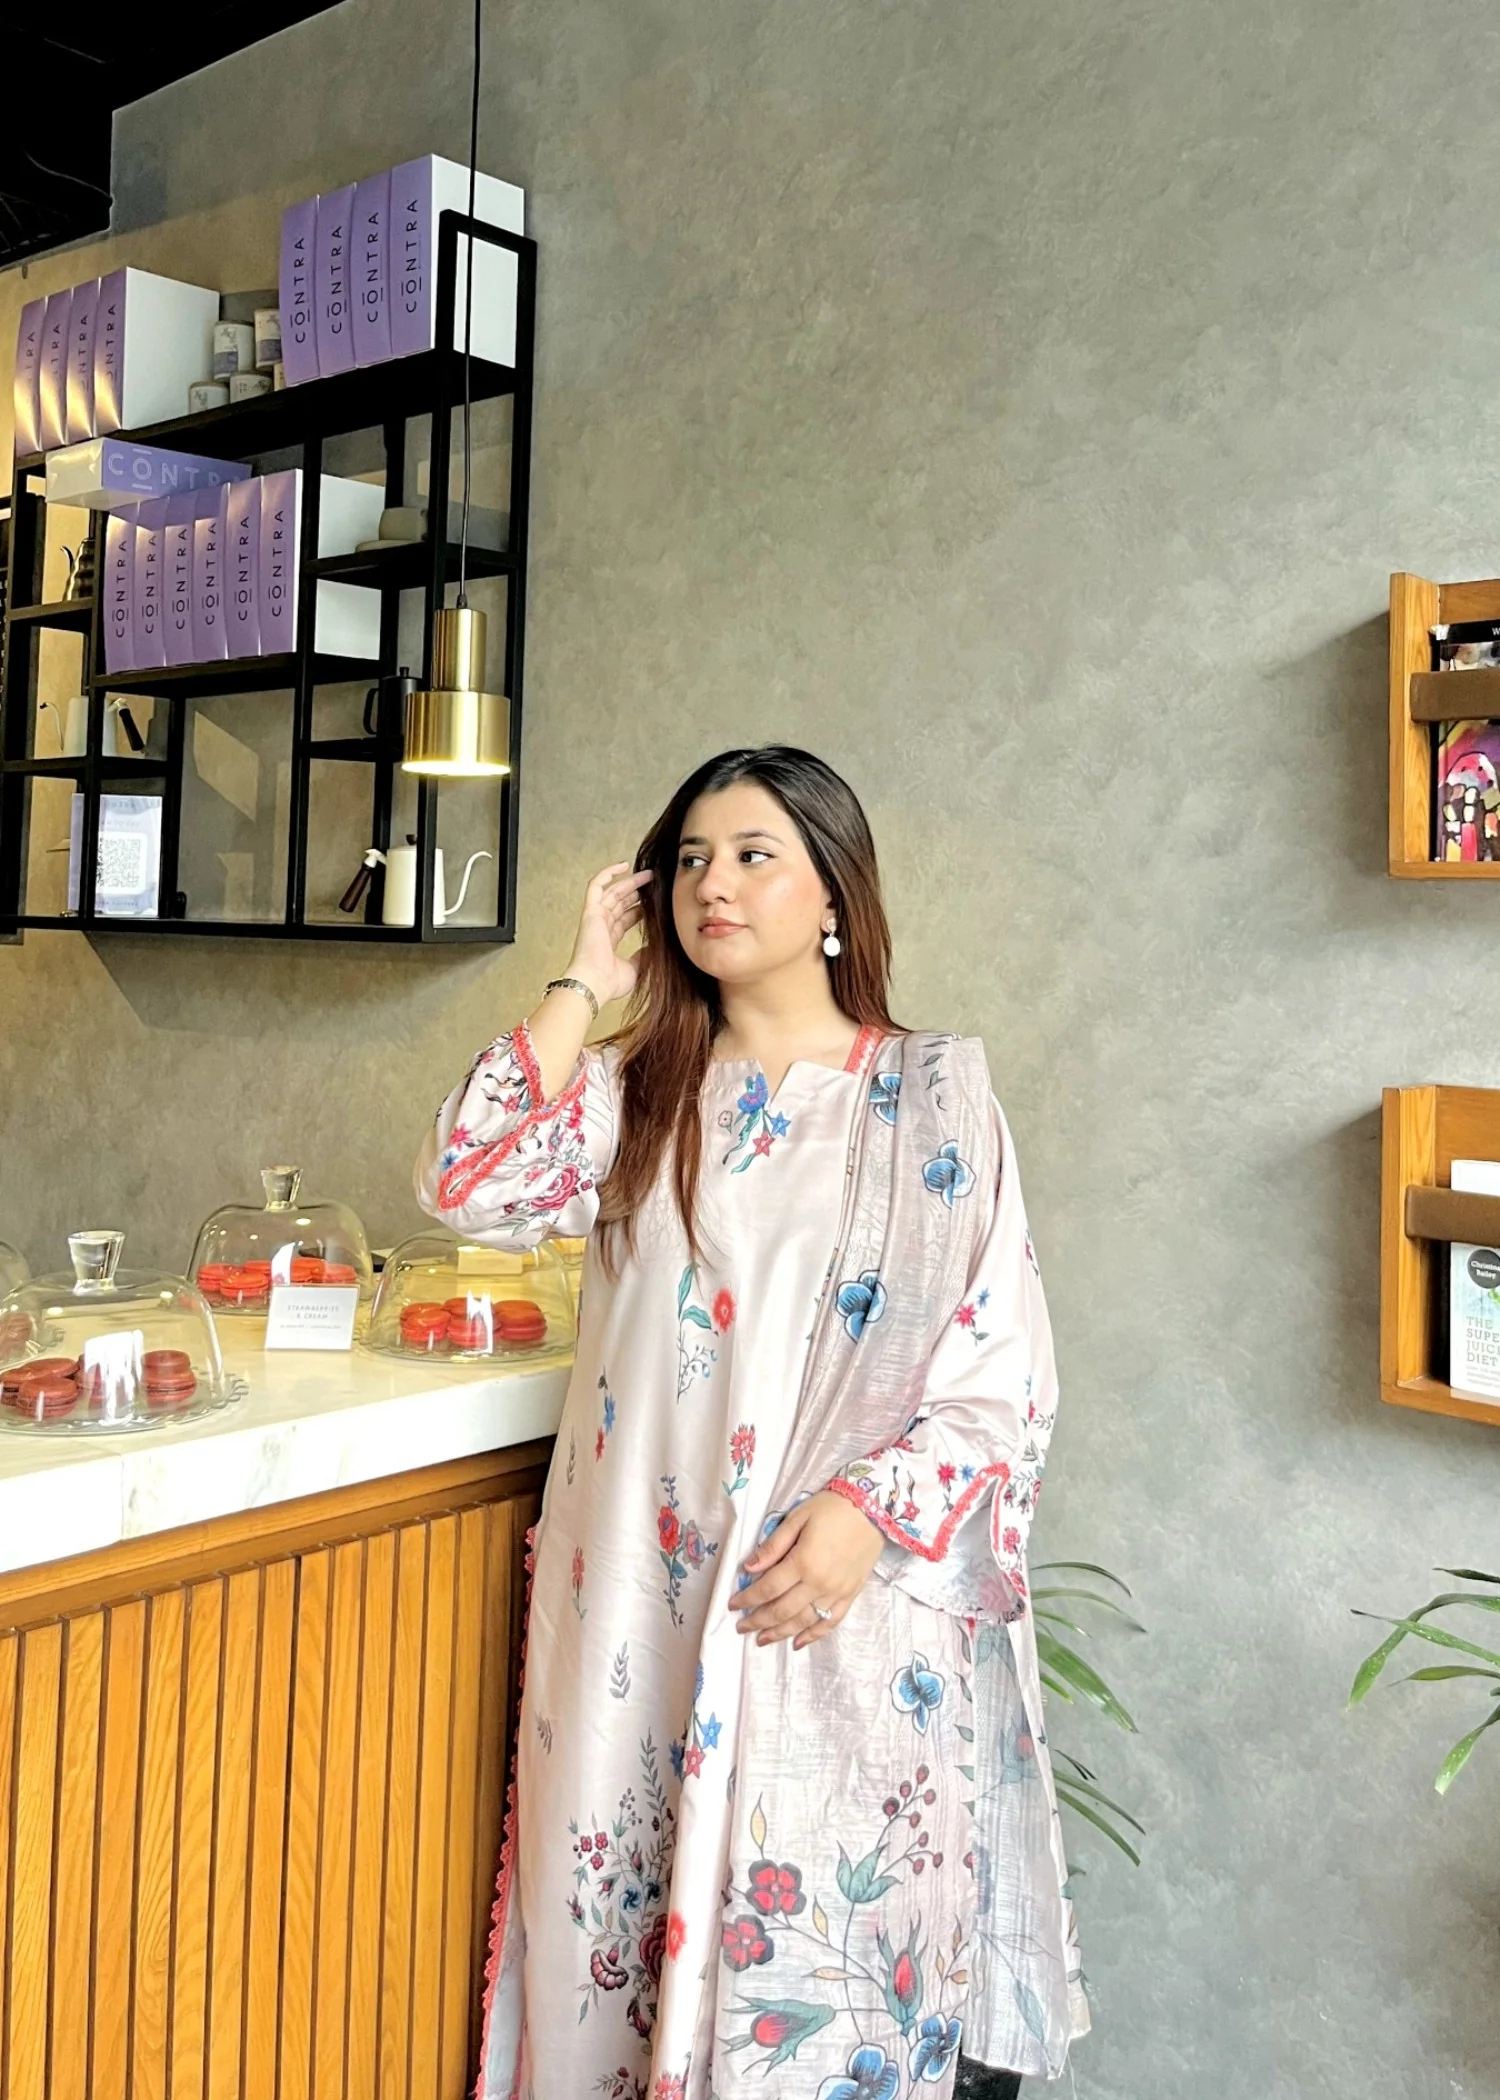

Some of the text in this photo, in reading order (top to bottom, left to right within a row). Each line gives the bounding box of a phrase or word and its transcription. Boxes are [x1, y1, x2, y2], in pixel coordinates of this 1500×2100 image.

[303, 1312, 329, 1320] CREAM
[1466, 1315, 1493, 1330] THE
[1467, 1352, 1498, 1367] DIET
